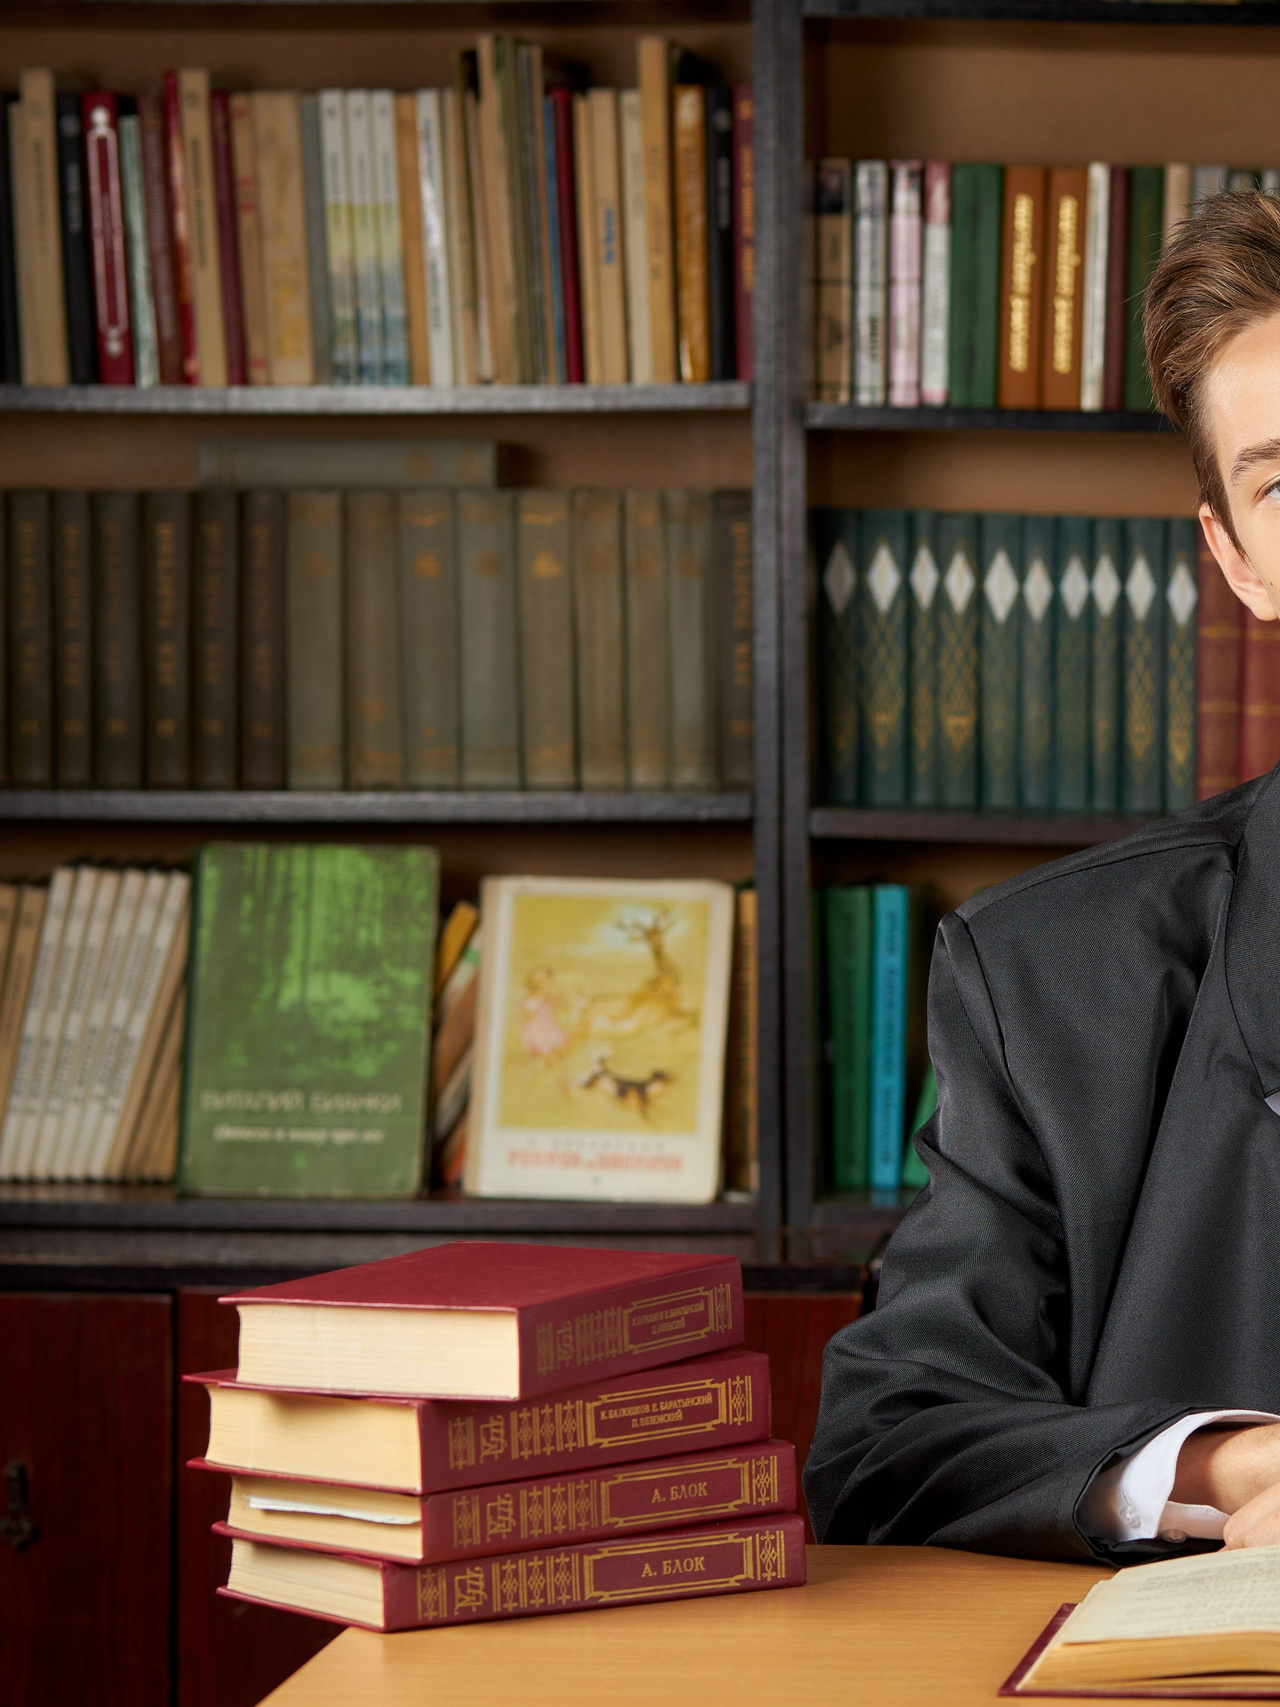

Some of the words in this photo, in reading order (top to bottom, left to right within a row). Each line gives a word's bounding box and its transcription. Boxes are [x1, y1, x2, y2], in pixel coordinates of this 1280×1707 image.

[660, 1392, 713, 1411] БАРАТЫНСКИЙ
[651, 1489, 666, 1504] А.
[670, 1481, 708, 1501] БЛОК
[641, 1562, 658, 1578] А.
[663, 1556, 706, 1576] БЛОК
